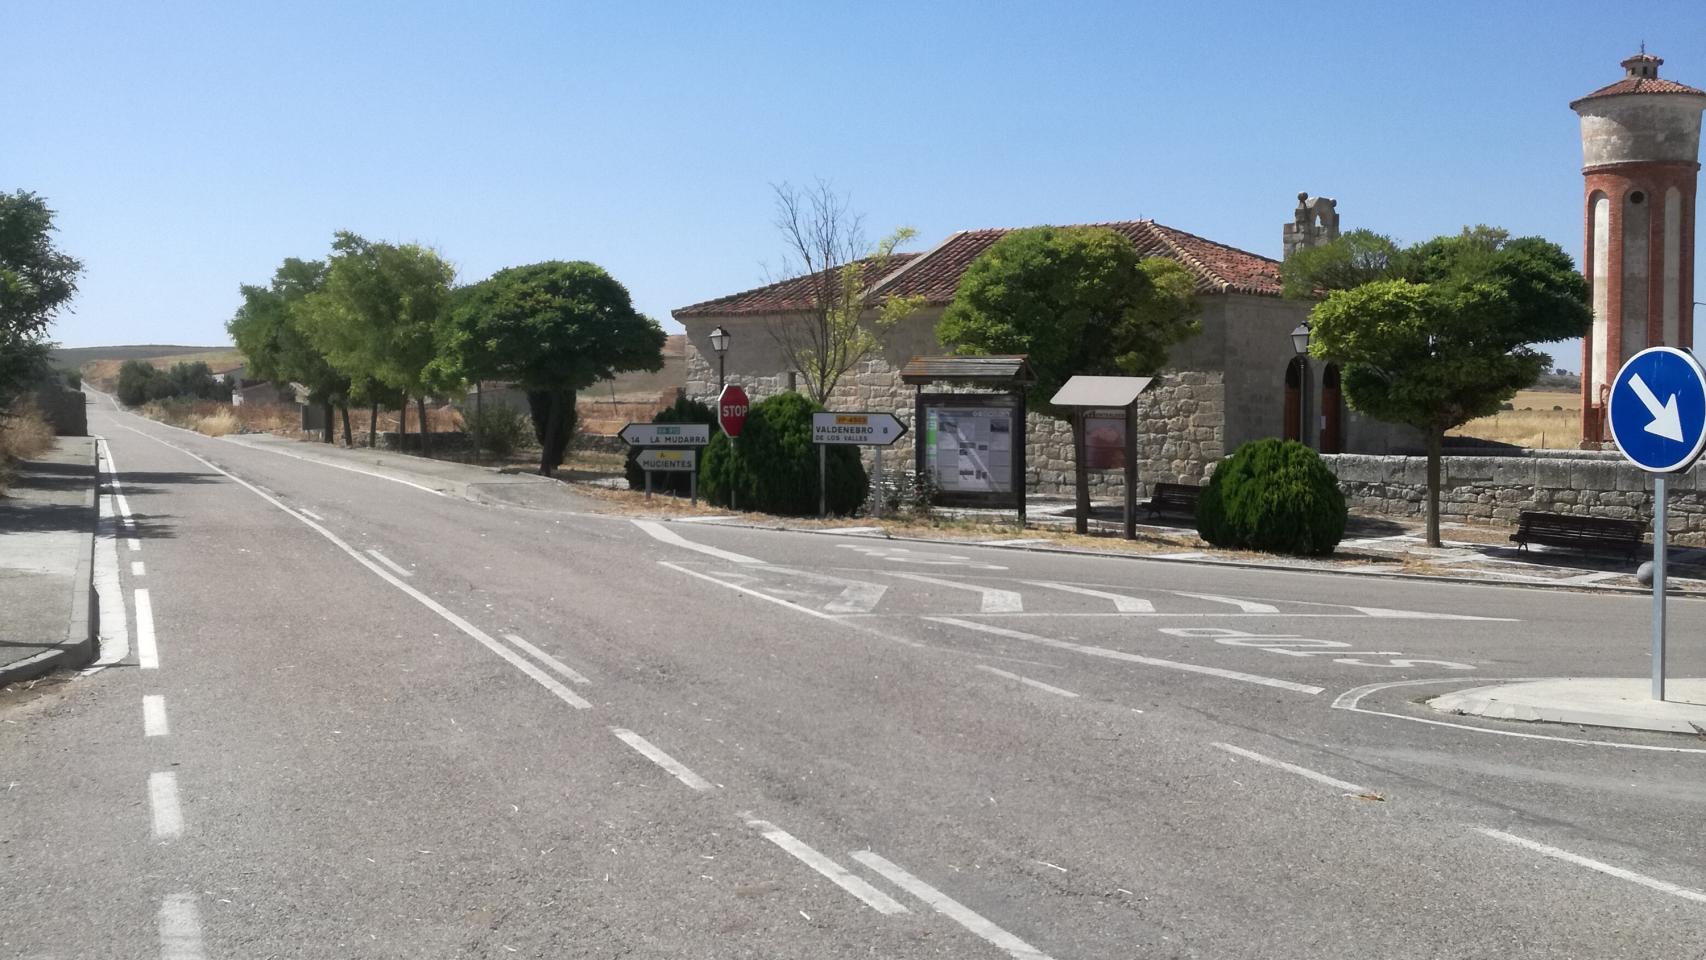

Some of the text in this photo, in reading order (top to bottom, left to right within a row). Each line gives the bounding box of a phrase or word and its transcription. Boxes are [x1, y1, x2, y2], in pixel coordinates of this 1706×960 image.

[722, 405, 748, 417] STOP
[815, 426, 874, 434] VALDENEBRO
[631, 436, 707, 444] 14 LA MUDARRA
[642, 460, 692, 468] MUCIENTES
[1158, 628, 1477, 670] STOP
